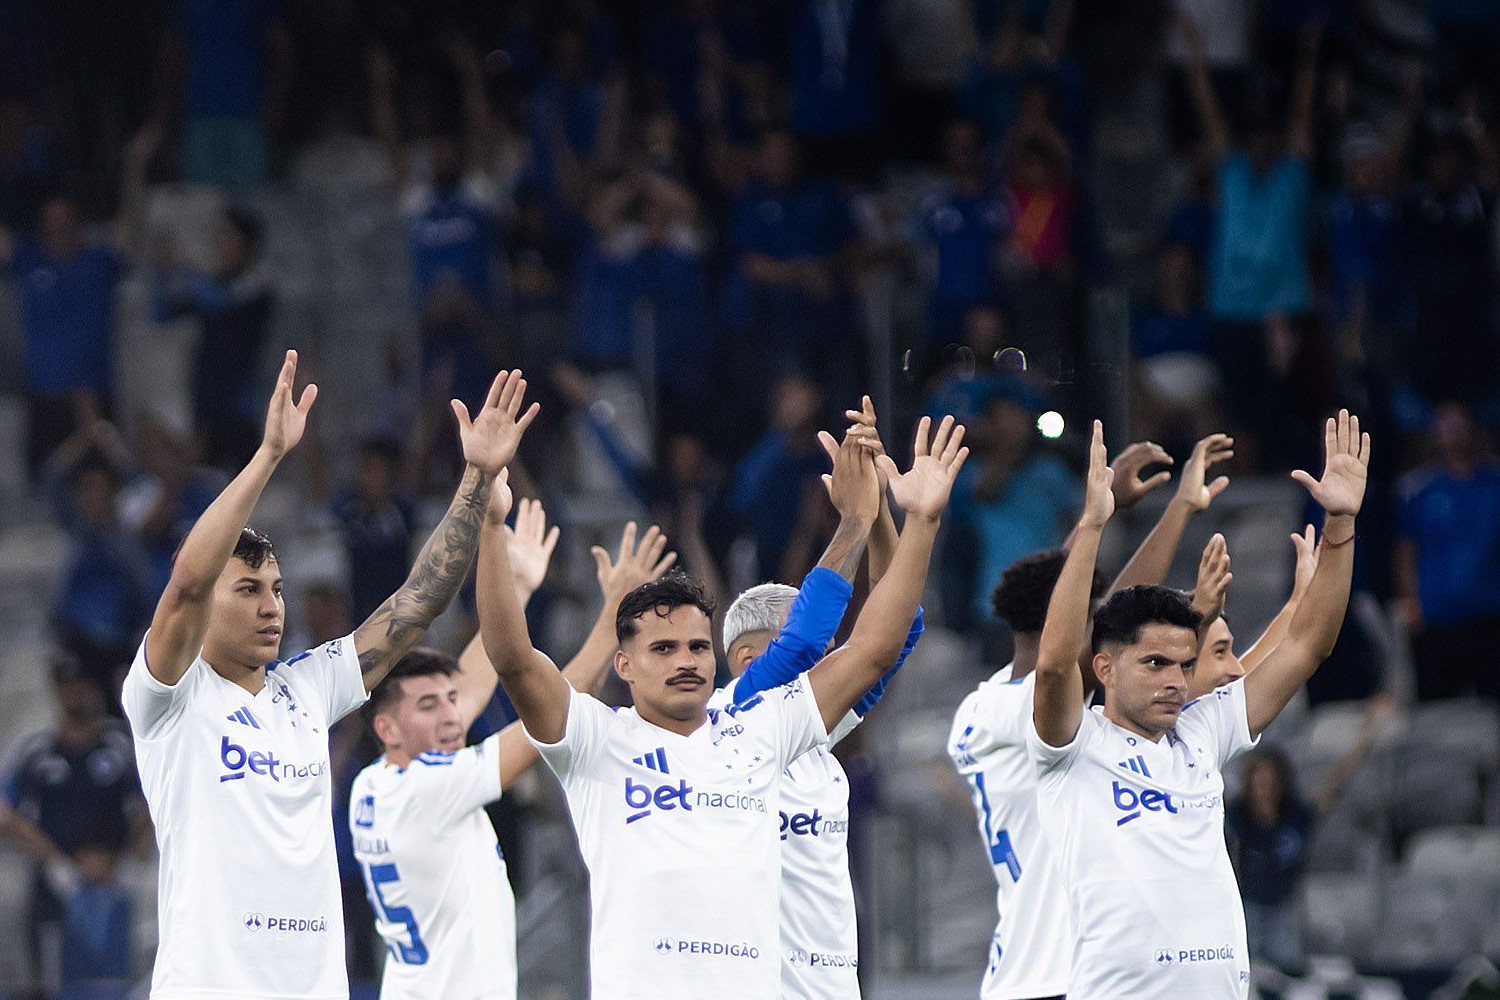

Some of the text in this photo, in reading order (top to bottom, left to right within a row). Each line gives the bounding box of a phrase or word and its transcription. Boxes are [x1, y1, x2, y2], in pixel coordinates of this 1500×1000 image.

[220, 735, 280, 782] bet
[625, 777, 768, 814] bet nacional
[268, 916, 327, 932] PERDIGÃ
[359, 863, 429, 965] 5
[678, 941, 759, 959] PERDIGÃO
